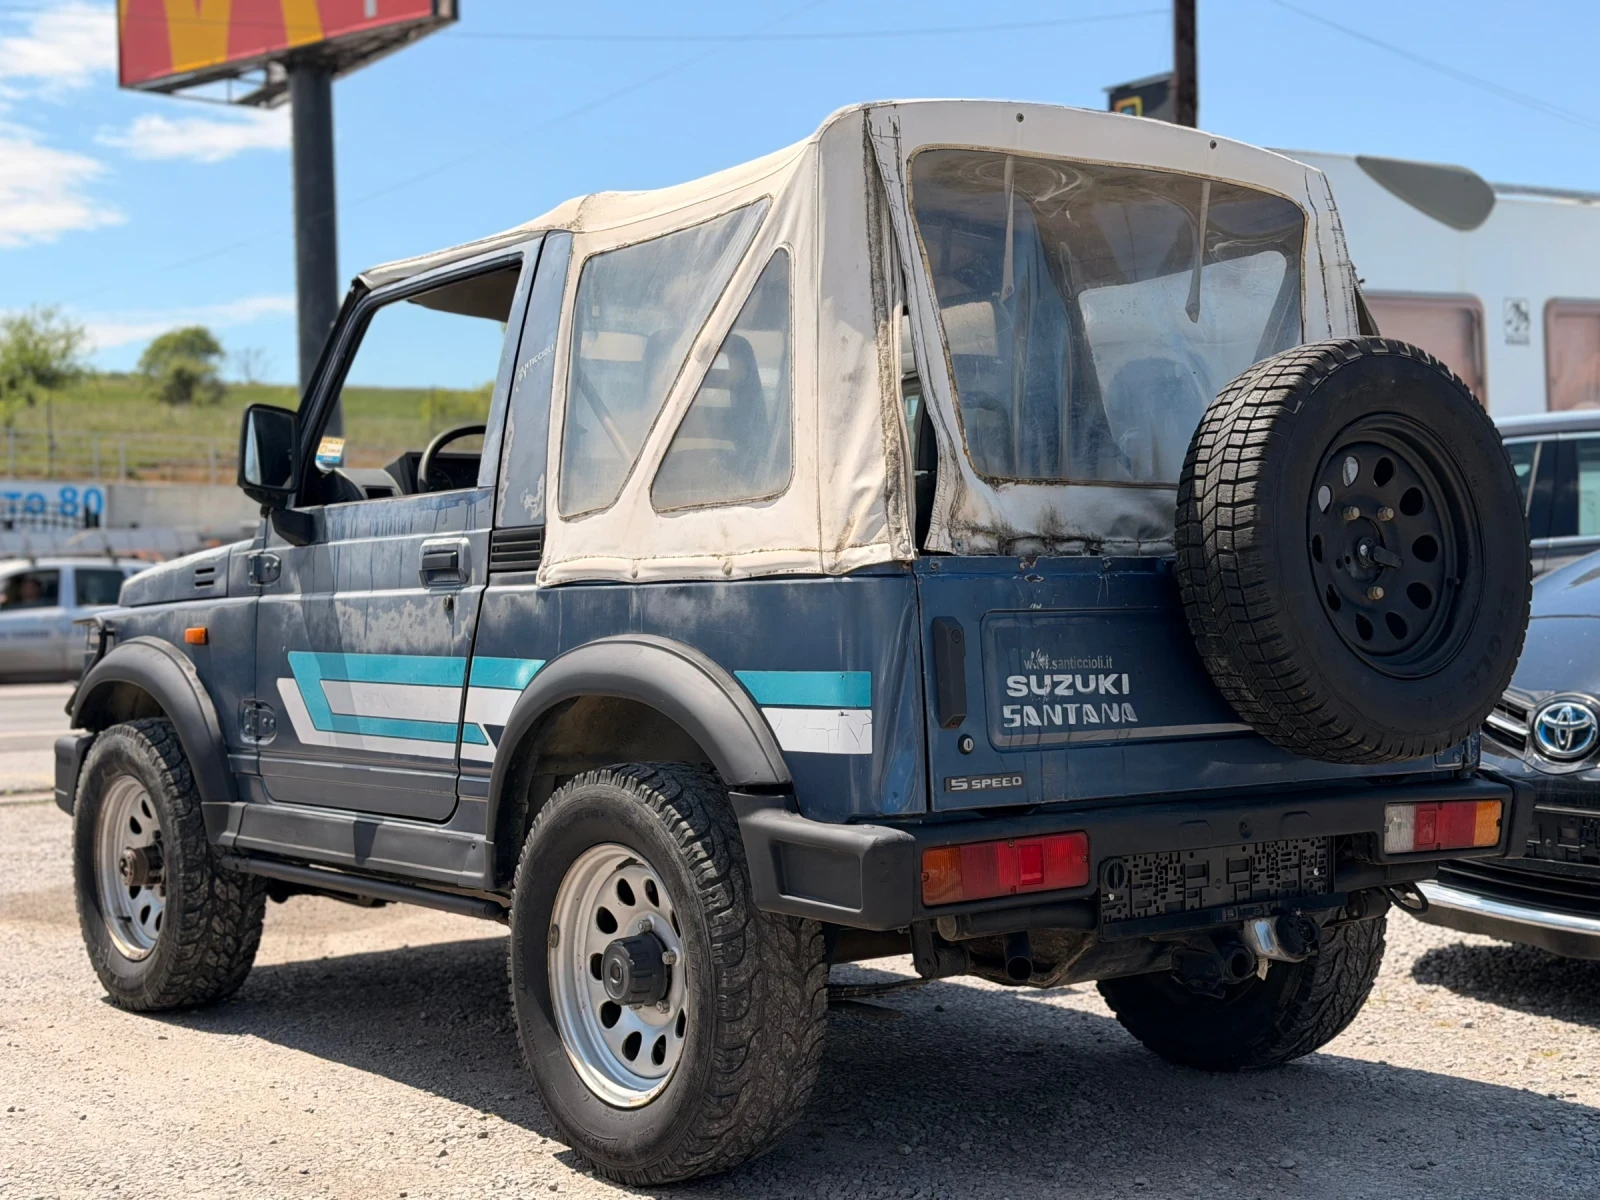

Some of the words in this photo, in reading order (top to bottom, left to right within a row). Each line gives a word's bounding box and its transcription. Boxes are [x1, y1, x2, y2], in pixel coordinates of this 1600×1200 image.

[58, 486, 104, 517] 80
[1006, 673, 1129, 697] SUZUKI
[1003, 702, 1138, 727] SANTANA
[951, 778, 968, 790] 5
[971, 776, 1022, 789] SPEED
